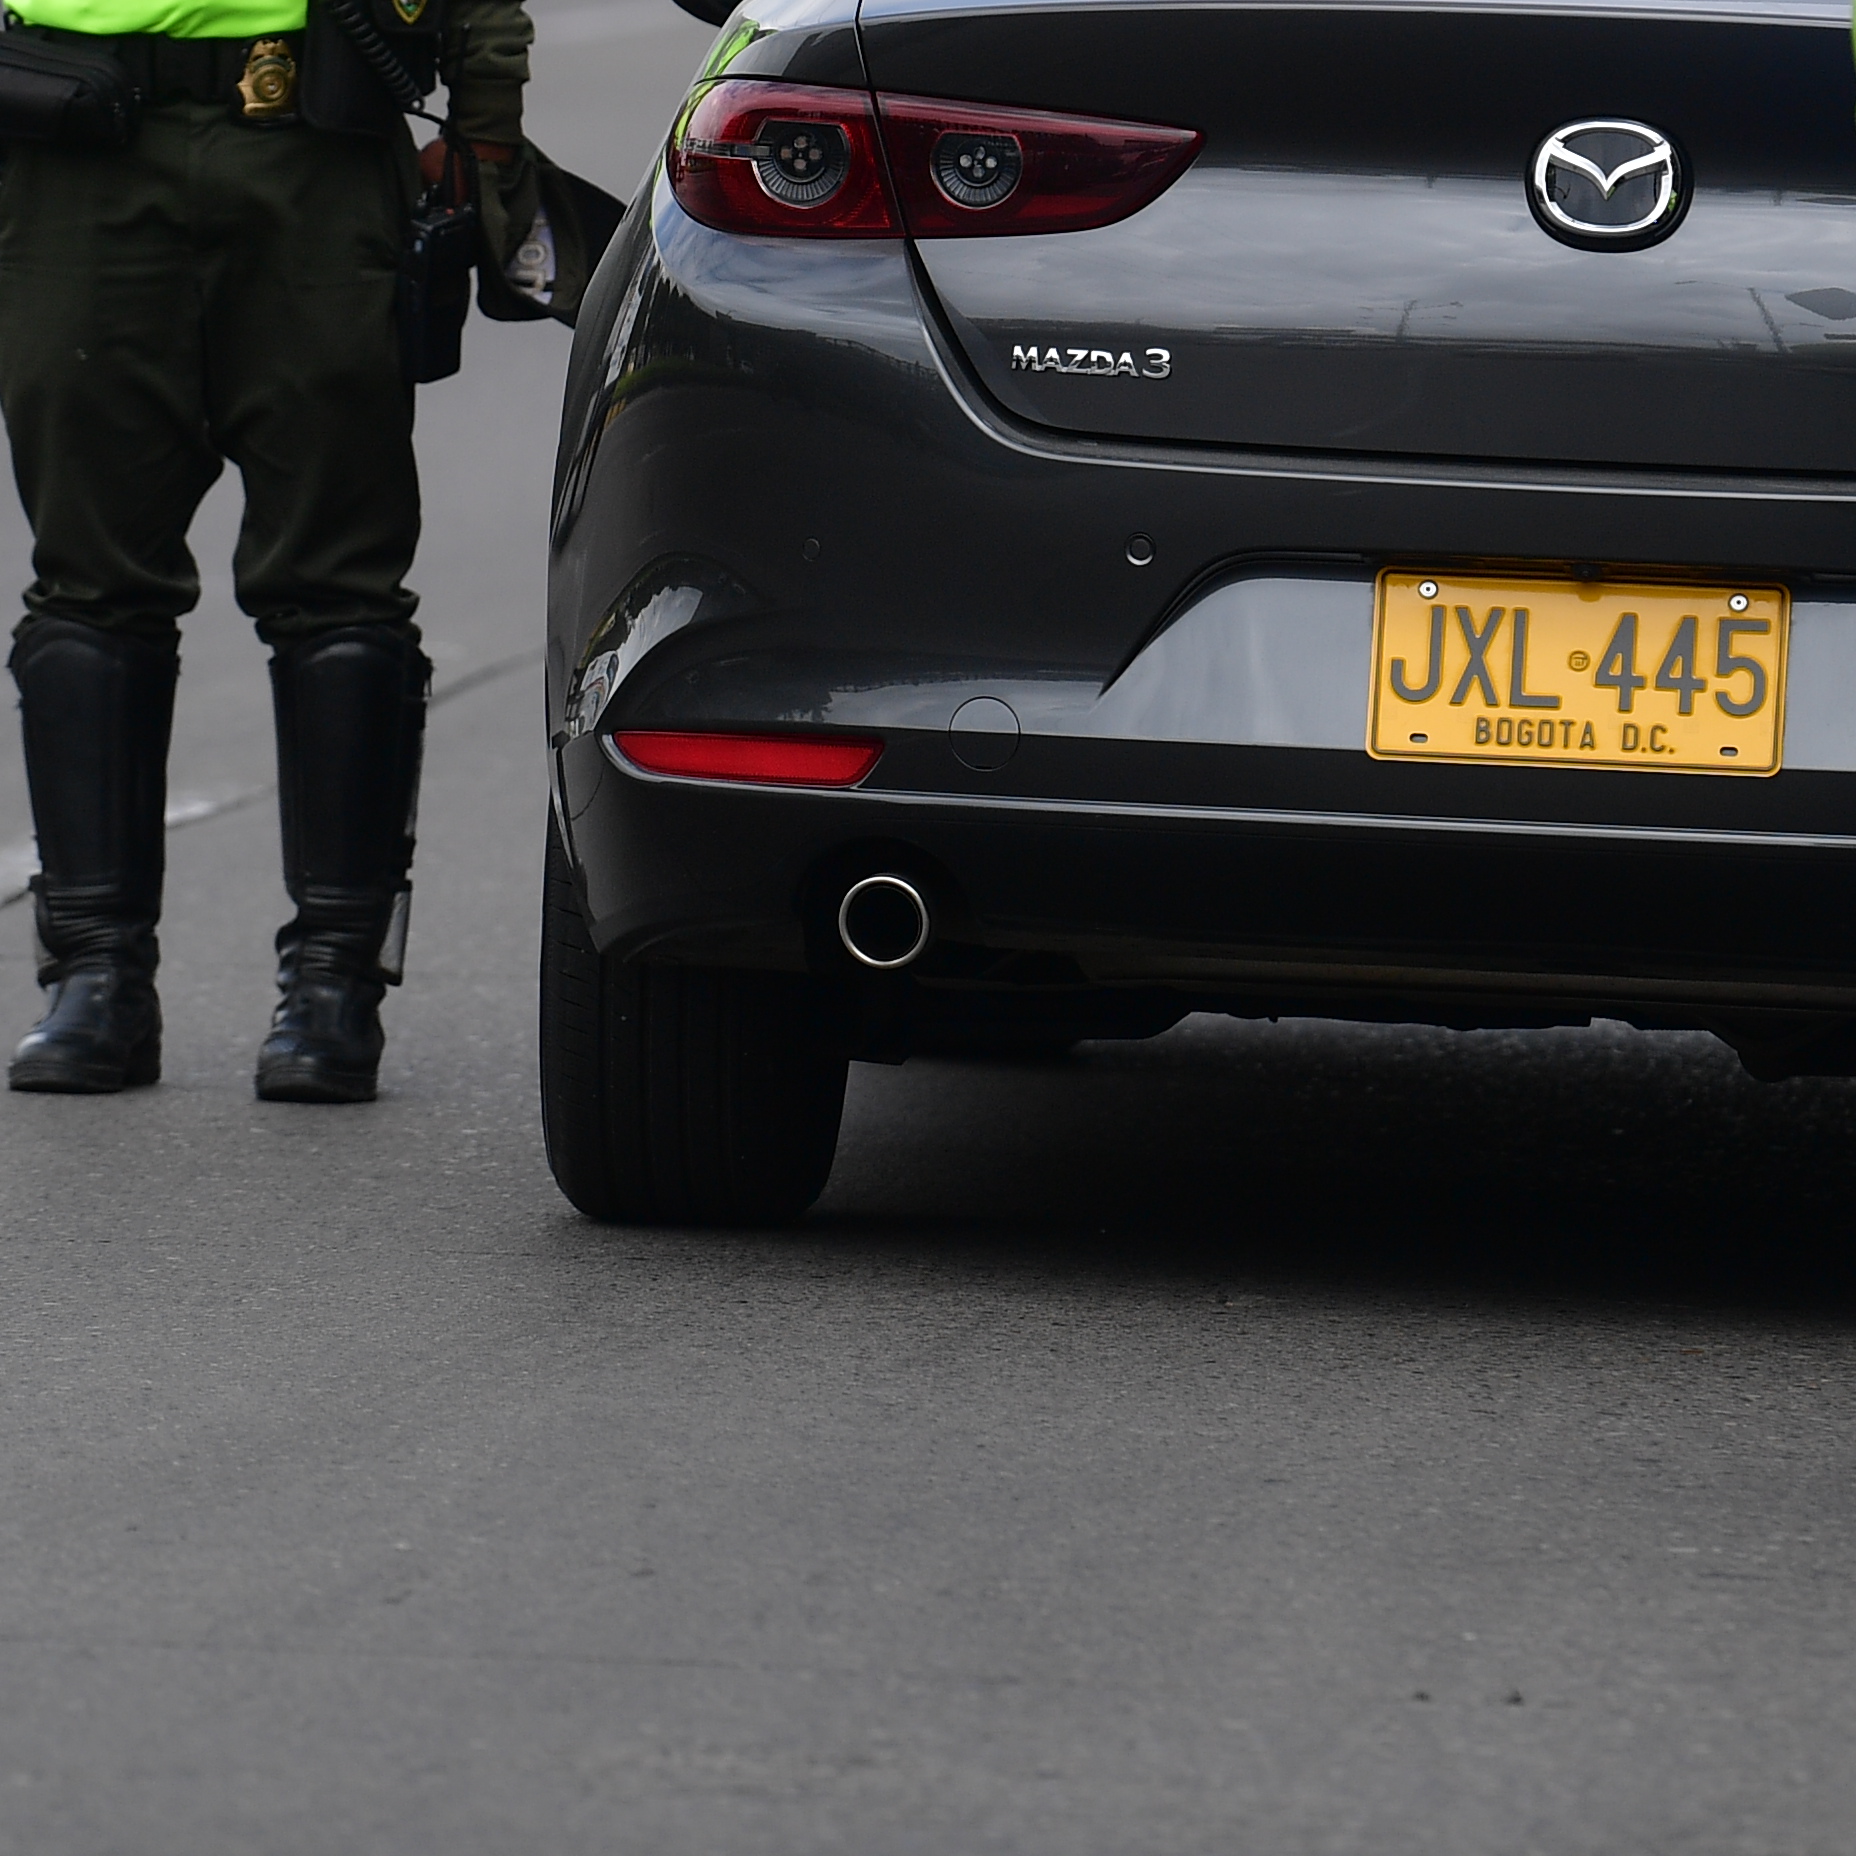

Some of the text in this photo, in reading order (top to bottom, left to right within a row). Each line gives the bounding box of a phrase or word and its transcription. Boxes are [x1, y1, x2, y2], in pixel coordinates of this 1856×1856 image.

[1390, 604, 1769, 717] JXL 445
[1474, 717, 1676, 755] BOGOTA D.C.
